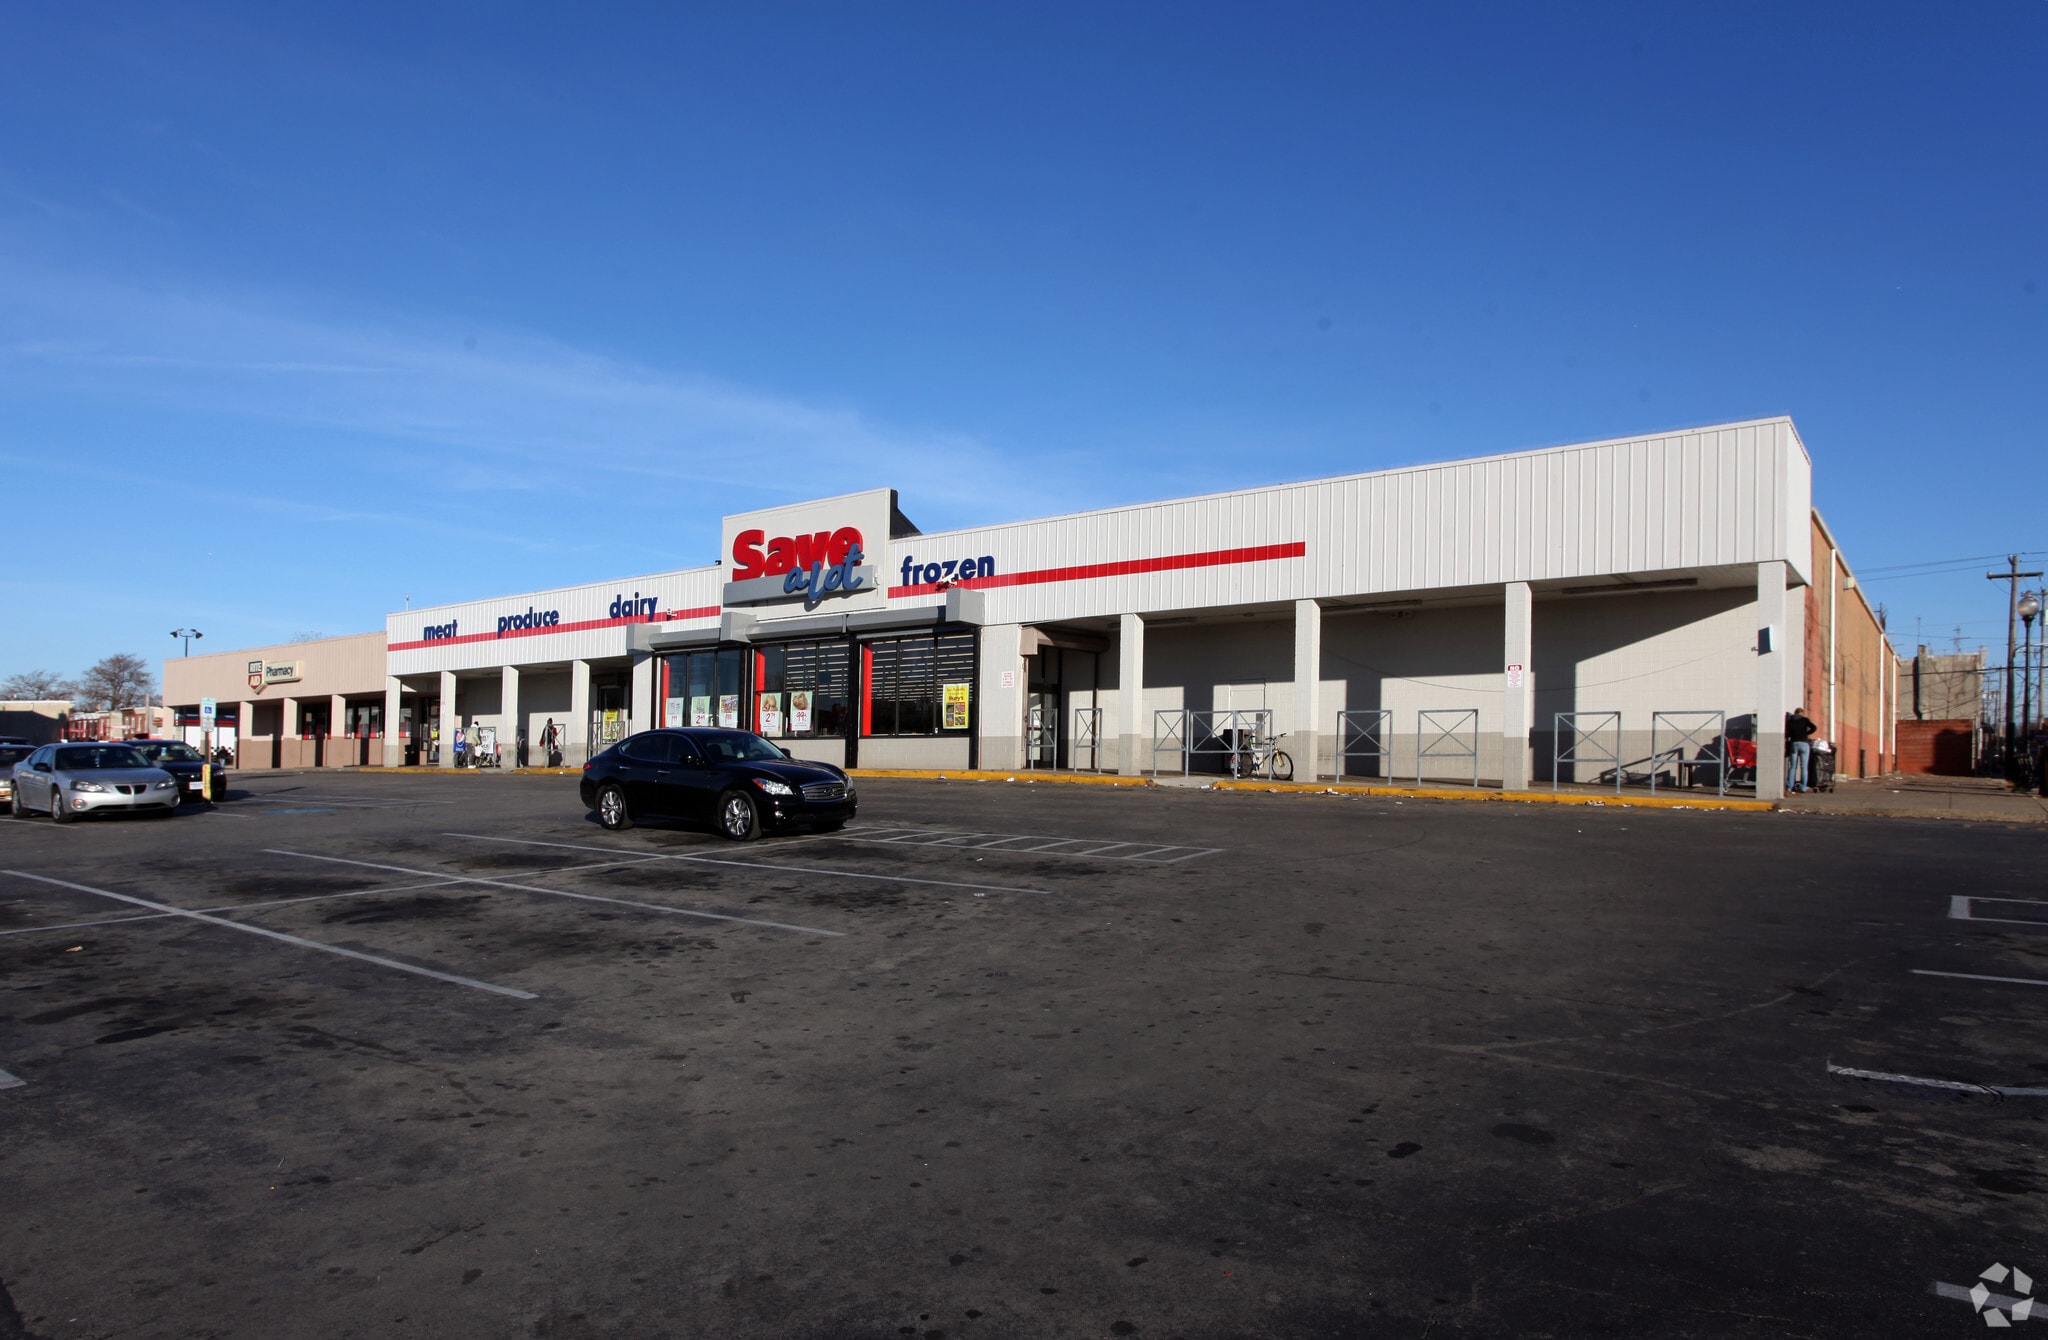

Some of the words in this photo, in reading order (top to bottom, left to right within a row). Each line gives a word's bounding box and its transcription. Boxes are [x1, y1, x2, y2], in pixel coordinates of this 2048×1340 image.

[732, 526, 864, 582] Save
[901, 555, 995, 586] frozen
[609, 592, 658, 621] dairy
[423, 619, 458, 641] meat
[497, 606, 559, 638] produce
[266, 666, 294, 677] Pharmacy
